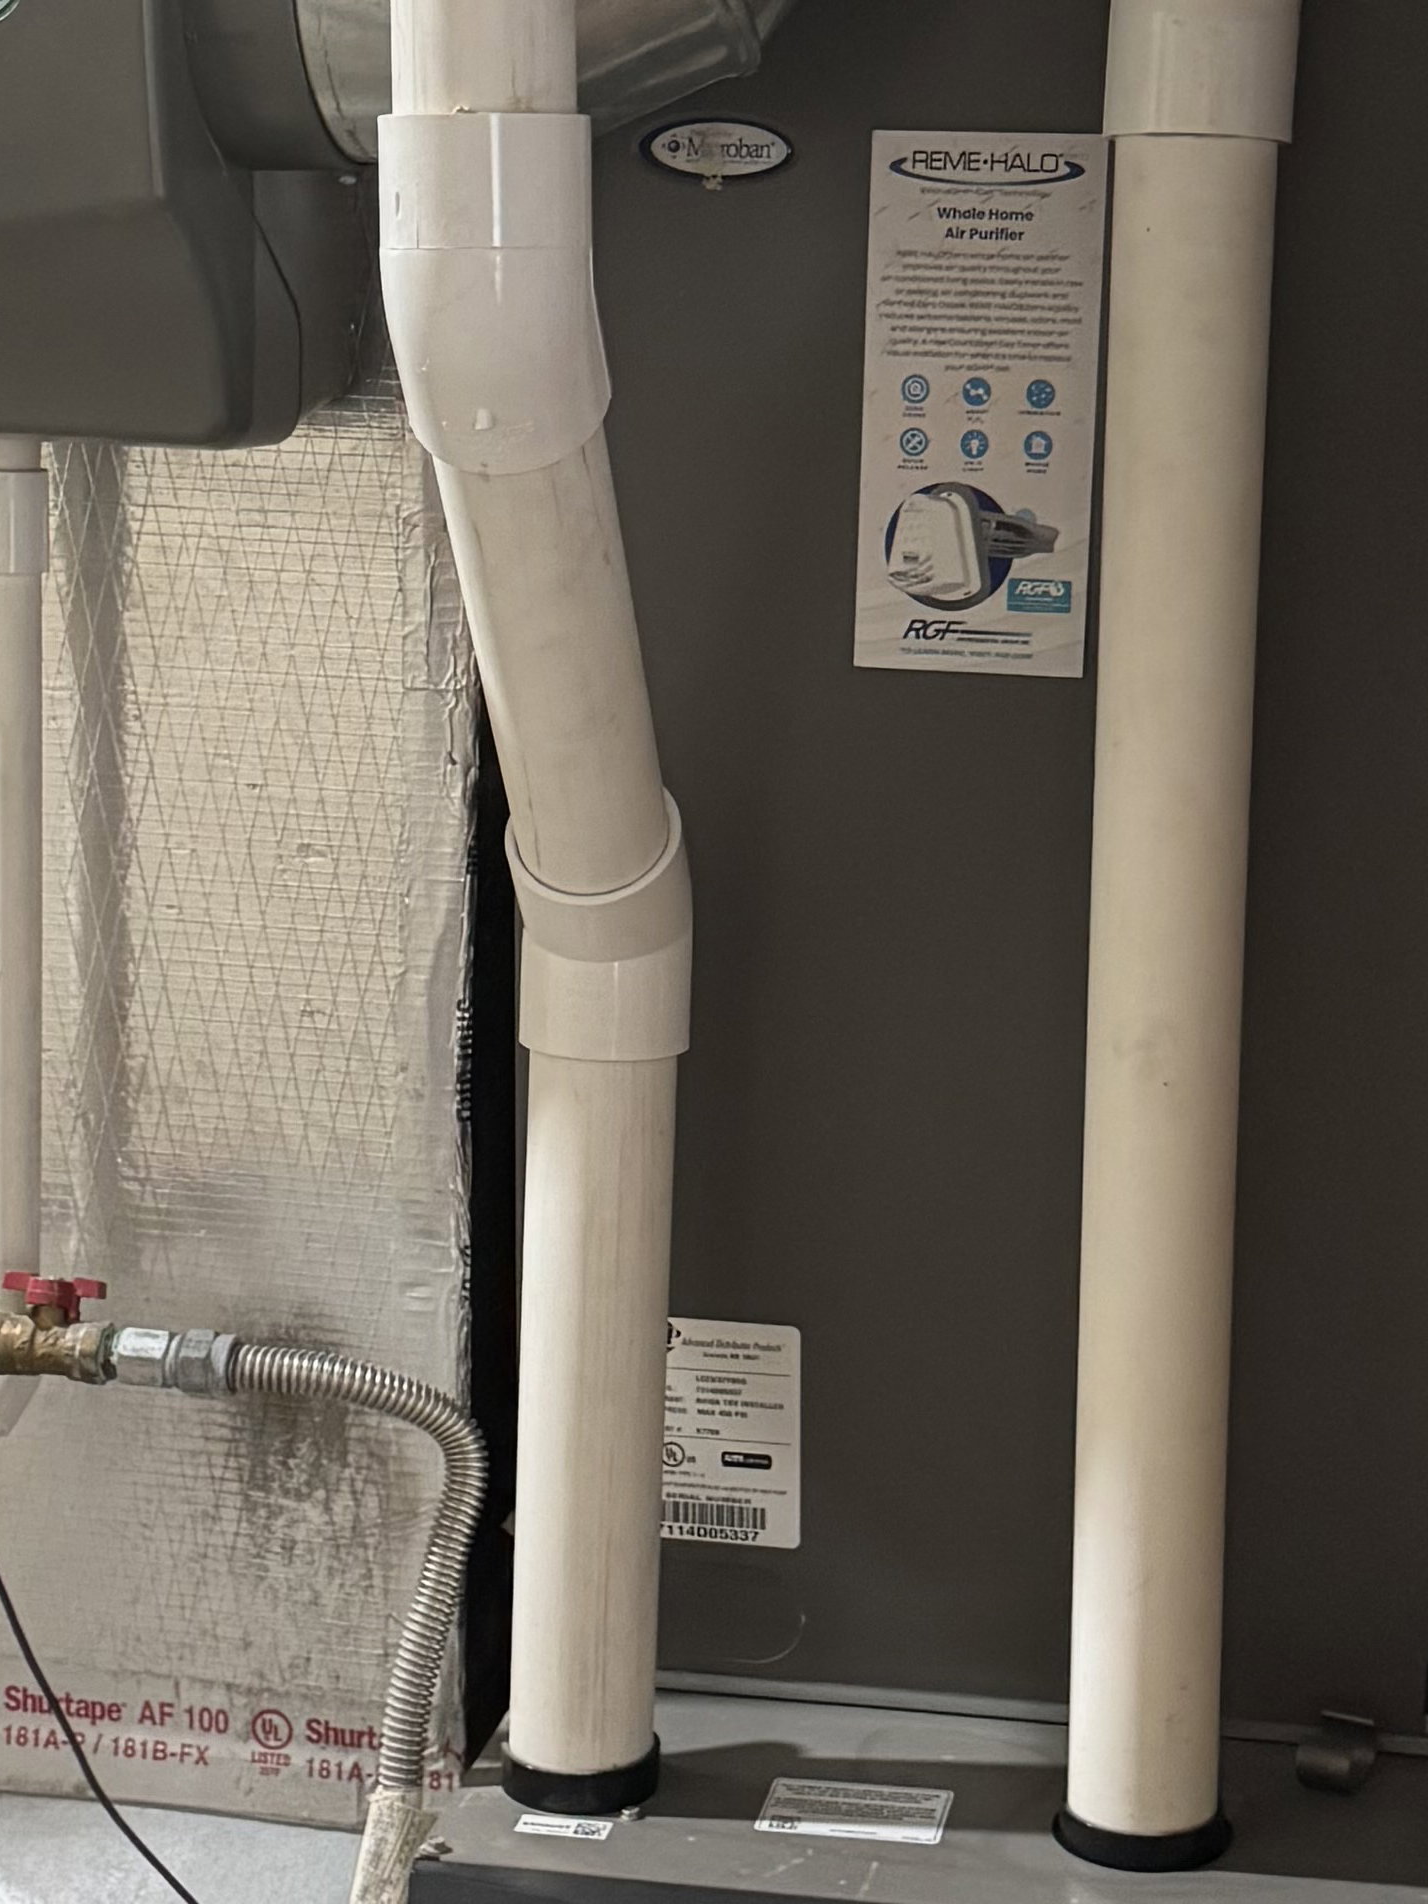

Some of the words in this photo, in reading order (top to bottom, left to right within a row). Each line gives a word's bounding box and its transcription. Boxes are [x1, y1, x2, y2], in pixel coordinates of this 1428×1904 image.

[686, 137, 774, 160] Mroban
[937, 207, 985, 220] Whole
[988, 208, 1034, 221] Home
[945, 227, 966, 239] Air
[970, 227, 1024, 241] Purifier
[903, 619, 967, 641] RGF
[138, 1700, 175, 1727] AF
[184, 1705, 229, 1735] 100
[305, 1717, 383, 1750] Shurt
[111, 1737, 210, 1766] 181B-FX
[251, 1751, 291, 1766] LISTED
[306, 1757, 373, 1783] 181A-
[429, 1769, 455, 1793] 81
